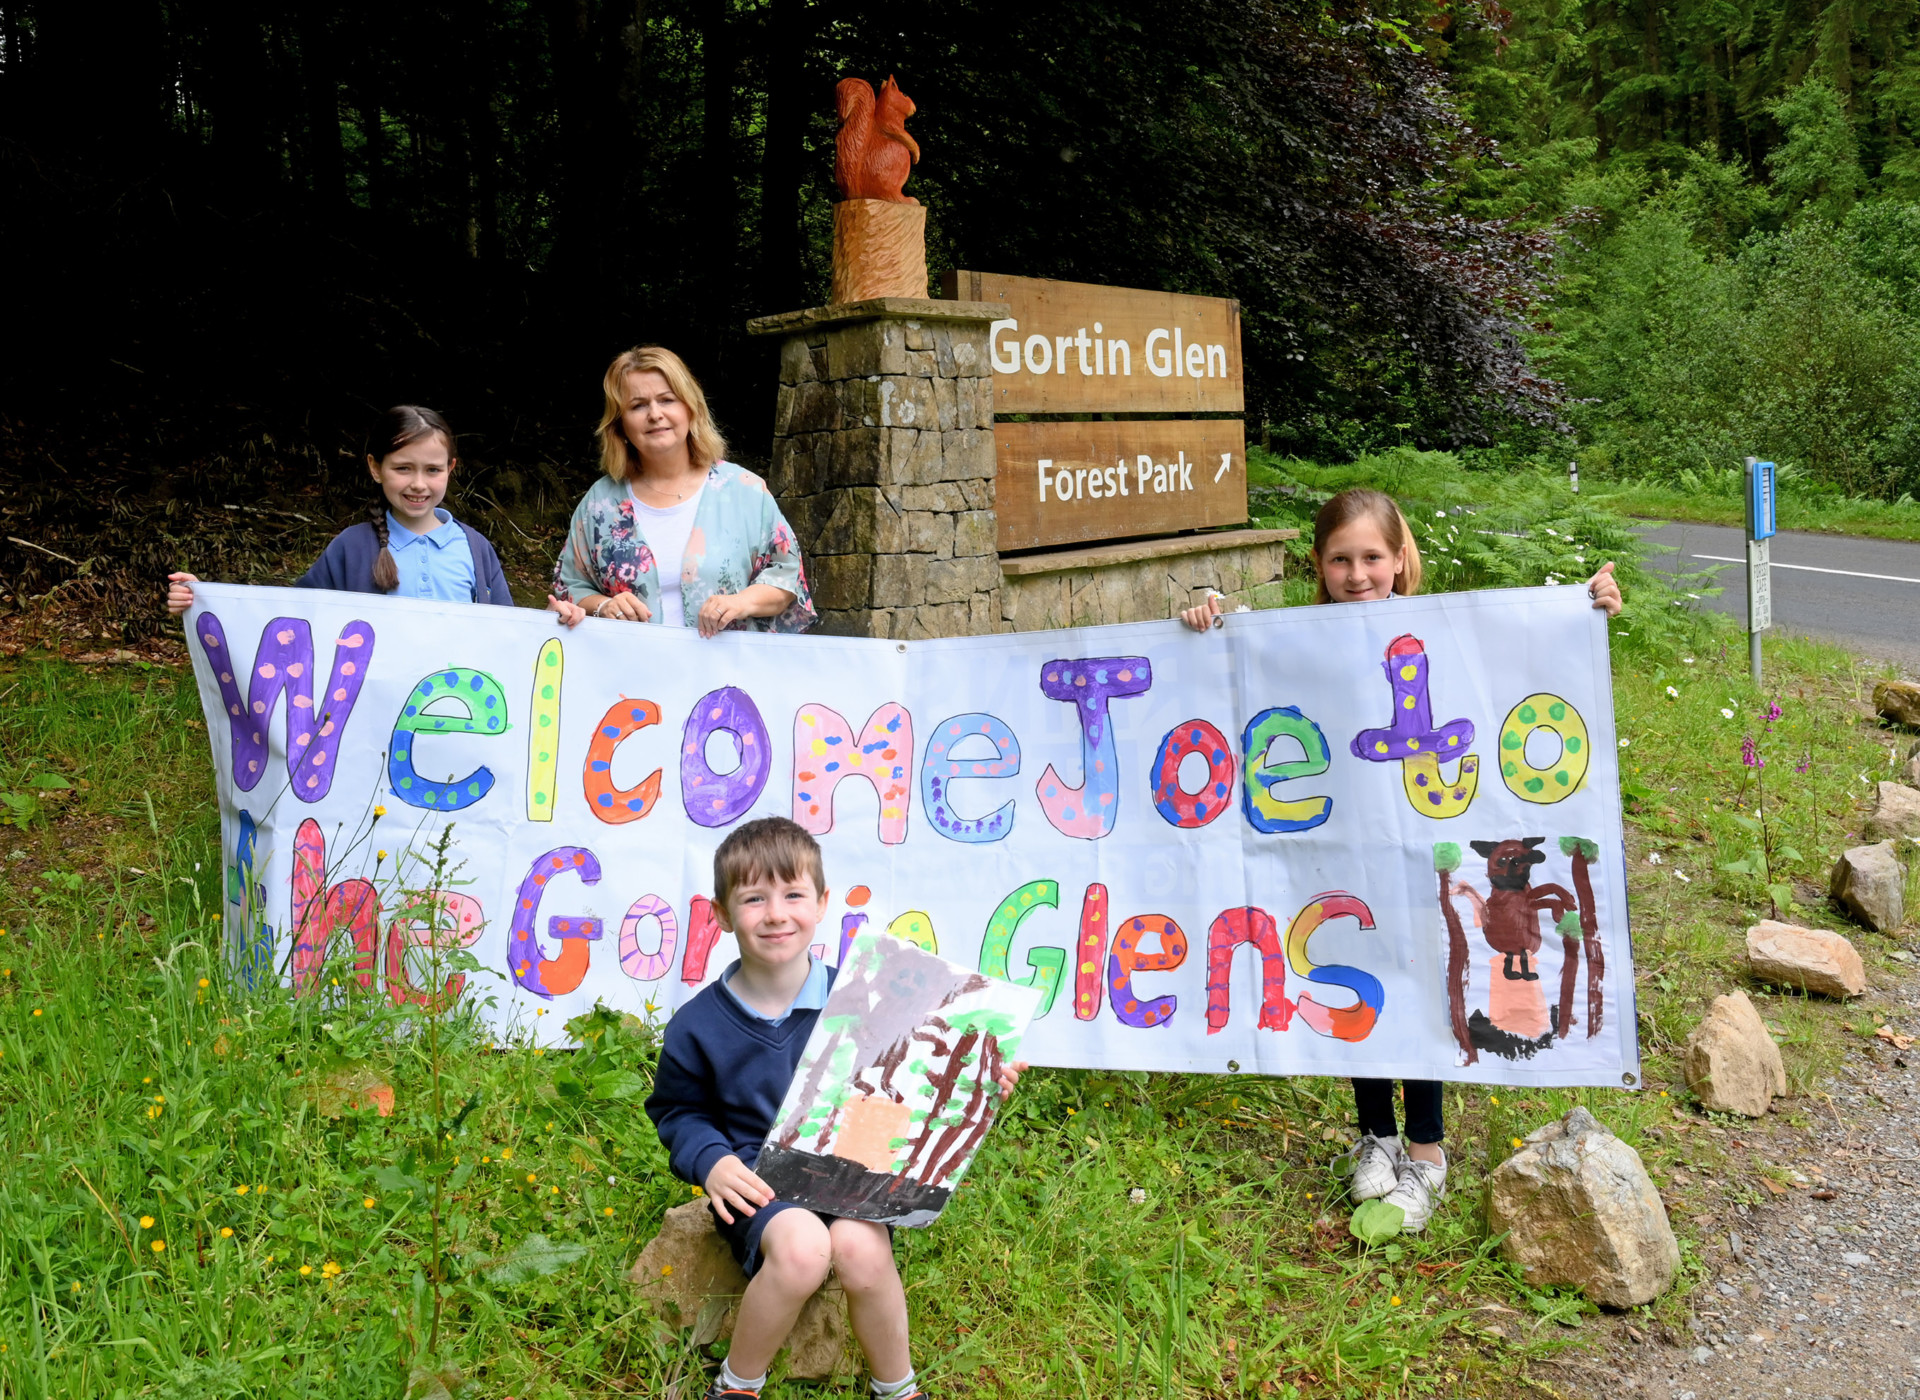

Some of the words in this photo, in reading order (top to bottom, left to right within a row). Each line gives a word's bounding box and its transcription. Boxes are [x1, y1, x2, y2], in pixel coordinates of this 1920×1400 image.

[989, 317, 1131, 376] Gortin
[1145, 327, 1227, 378] Glen
[1037, 459, 1129, 502] Forest
[1136, 451, 1194, 495] Park
[1035, 656, 1333, 841] Joe
[1350, 632, 1590, 819] to
[507, 845, 939, 1000] Gori
[979, 879, 1385, 1043] Glens
